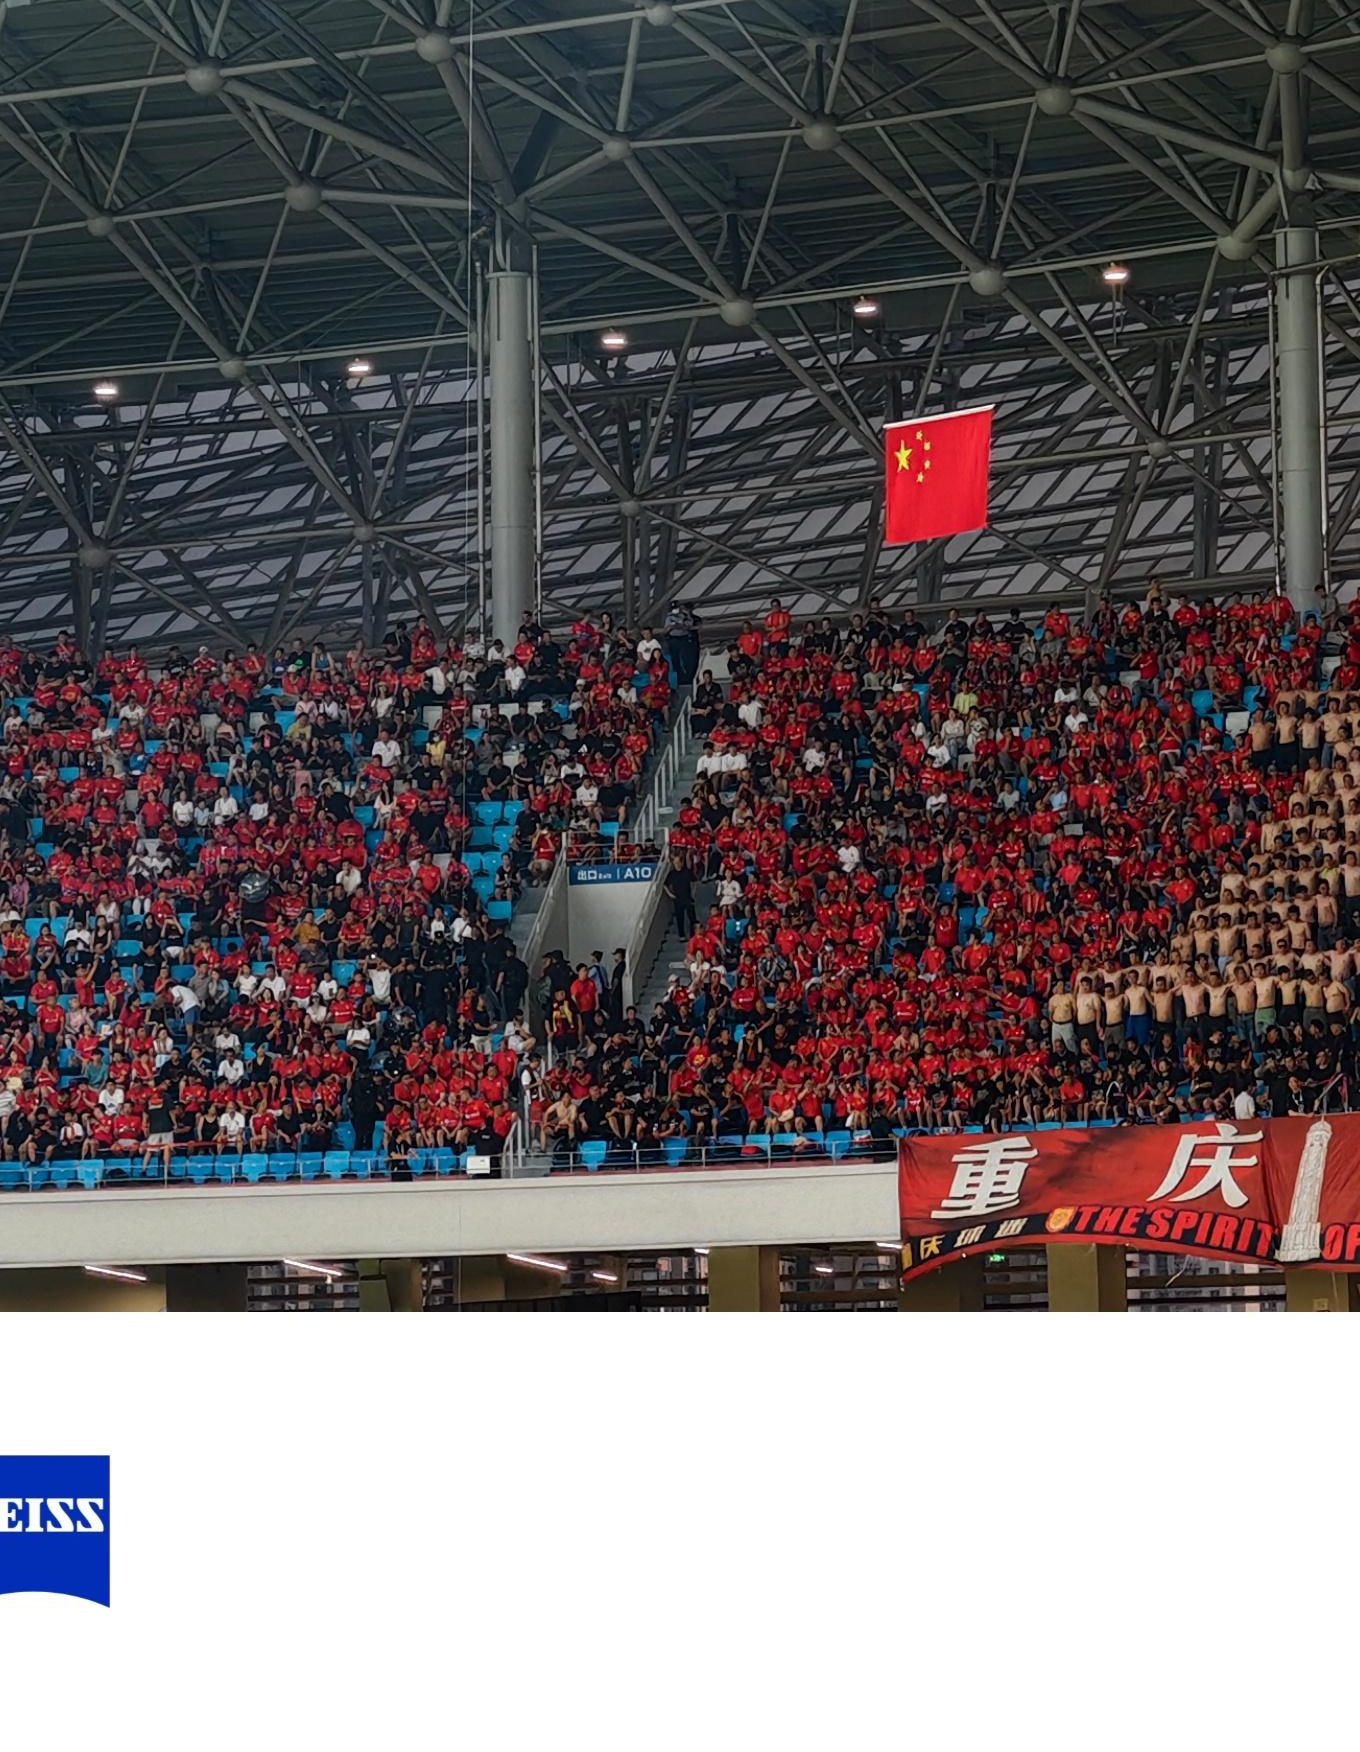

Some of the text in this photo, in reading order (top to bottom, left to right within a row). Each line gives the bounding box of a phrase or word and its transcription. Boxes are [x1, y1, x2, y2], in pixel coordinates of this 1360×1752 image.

[623, 866, 652, 880] A10
[1074, 1205, 1144, 1235] THE
[1145, 1207, 1277, 1258] SPIRIT
